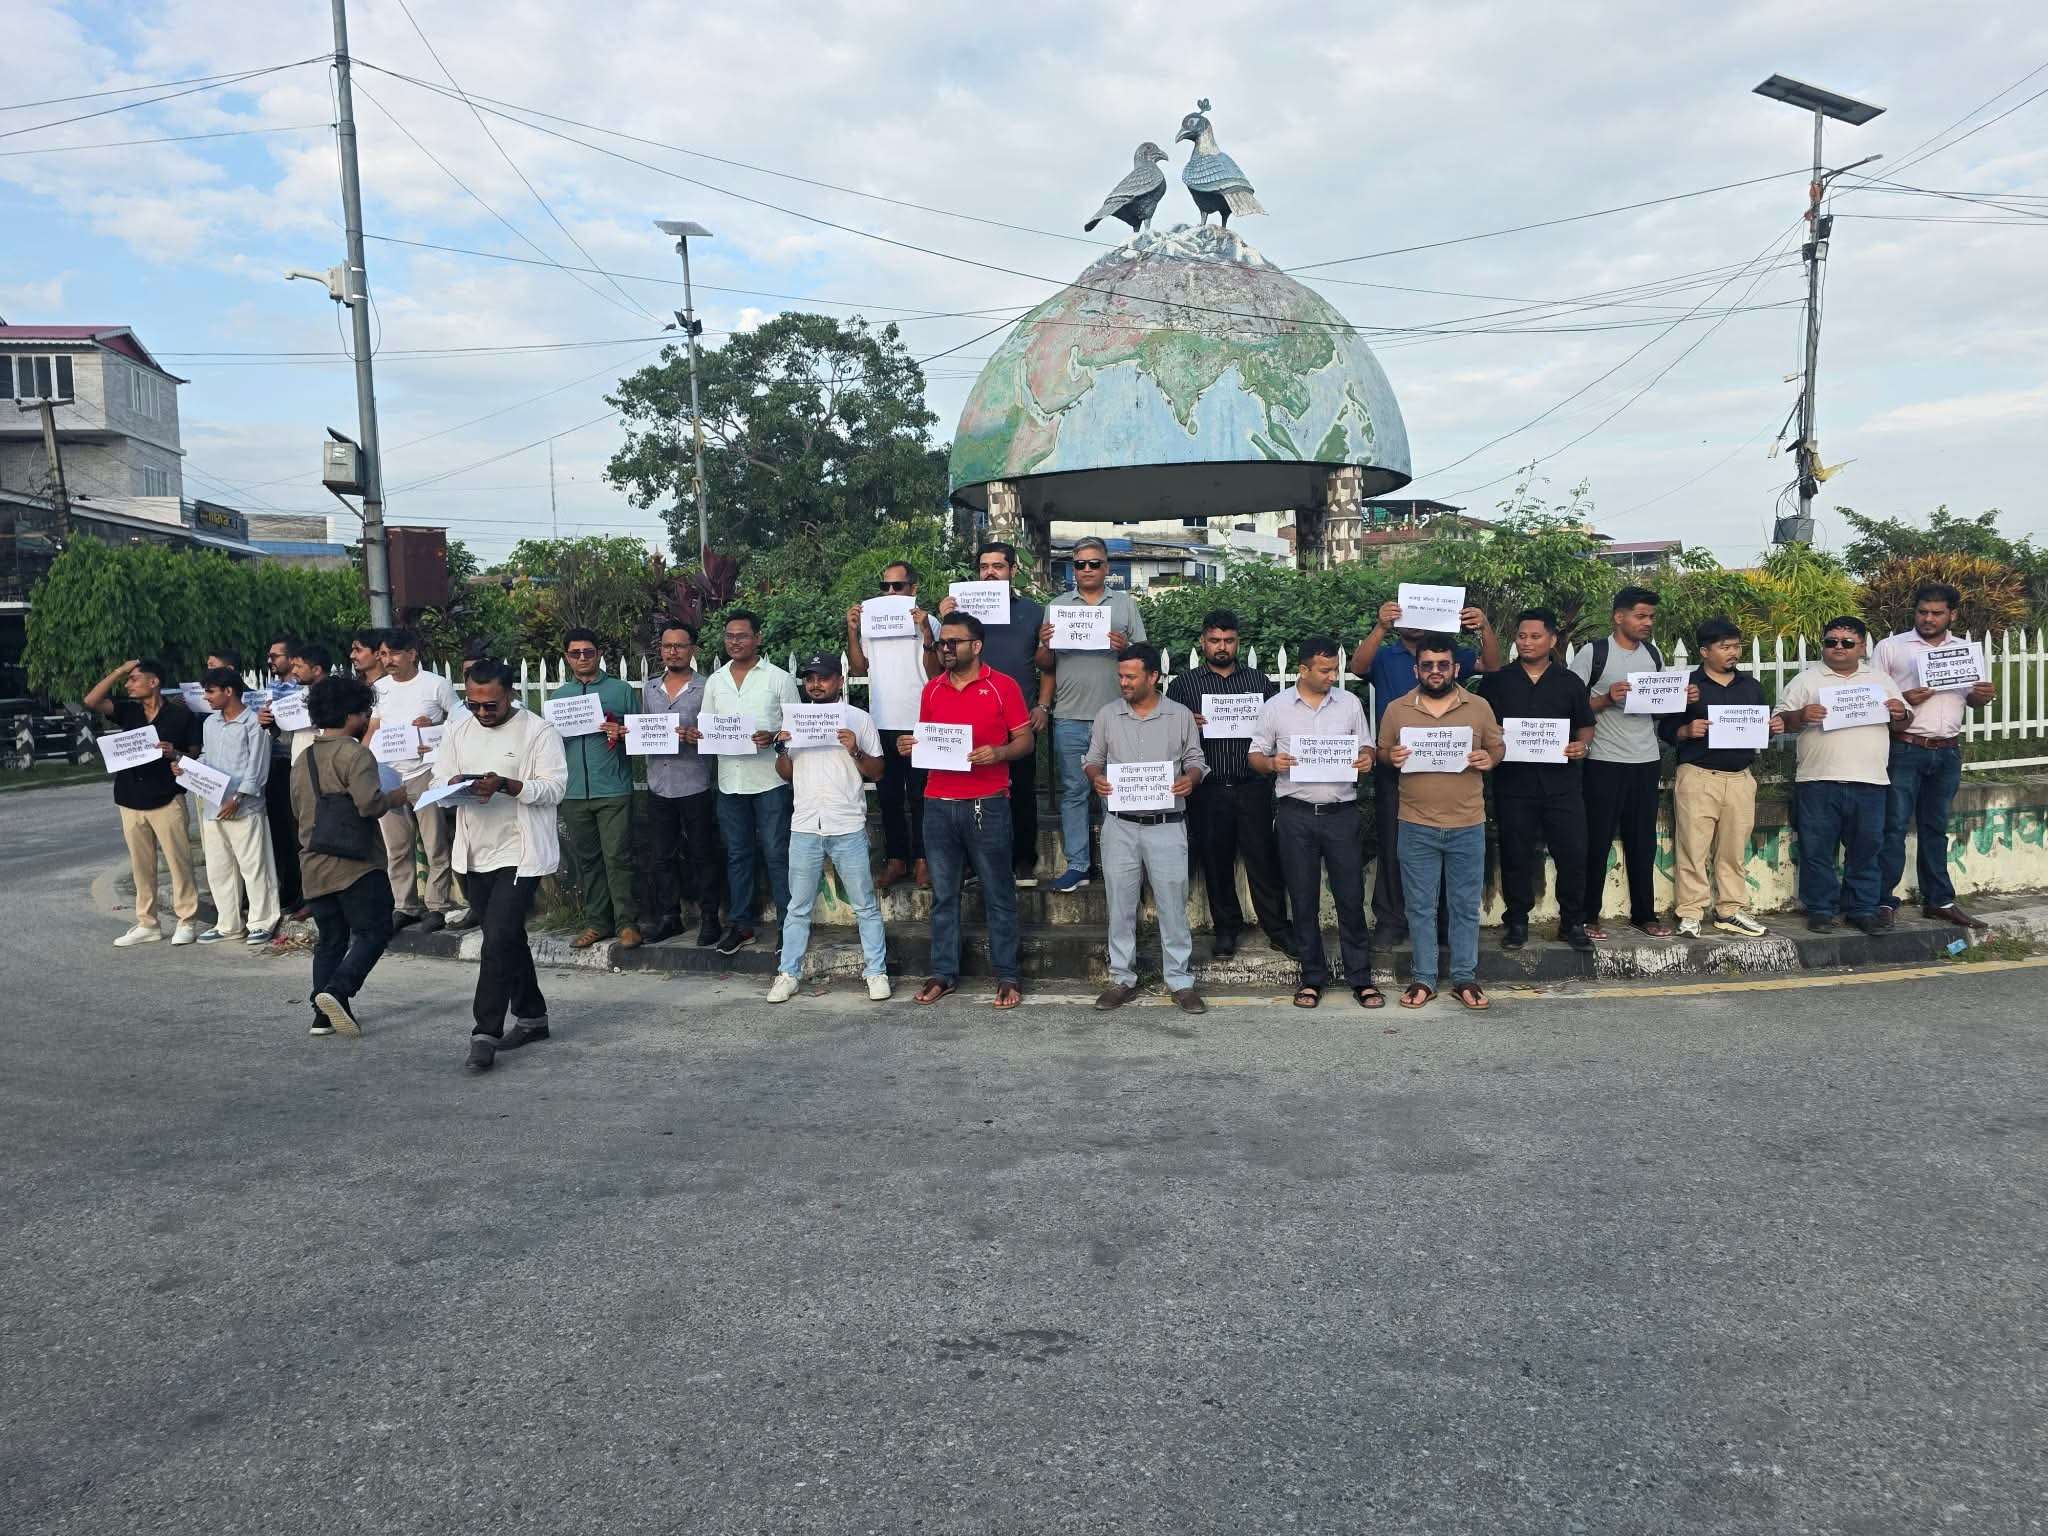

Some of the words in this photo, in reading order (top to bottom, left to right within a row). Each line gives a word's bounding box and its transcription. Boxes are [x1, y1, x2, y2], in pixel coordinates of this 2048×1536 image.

[1057, 609, 1076, 619] शिक्षा
[1078, 609, 1093, 619] सेवा
[1950, 657, 1974, 666] परामर्श
[1926, 670, 1951, 679] नियम
[1954, 667, 1978, 675] २०८३
[1637, 676, 1682, 685] सरोकारवाला
[1652, 687, 1680, 695] छलफल
[1235, 696, 1254, 704] लगानी
[1720, 715, 1748, 724] नियमावली
[1521, 721, 1538, 729] शिक्षा
[1539, 721, 1557, 729] क्षेत्रमा
[924, 725, 937, 734] नीति
[938, 727, 953, 735] सुधार
[641, 731, 668, 739] अधिकारको
[950, 737, 962, 745] बन्द
[1299, 737, 1318, 746] विदेश
[1452, 741, 1467, 749] दण्ड
[1435, 749, 1464, 757] प्रोत्साहन
[1299, 757, 1317, 765] नेपाल
[1318, 757, 1339, 765] निर्माण
[1117, 784, 1148, 793] विद्यार्थीको
[1149, 784, 1170, 792] भविष्य
